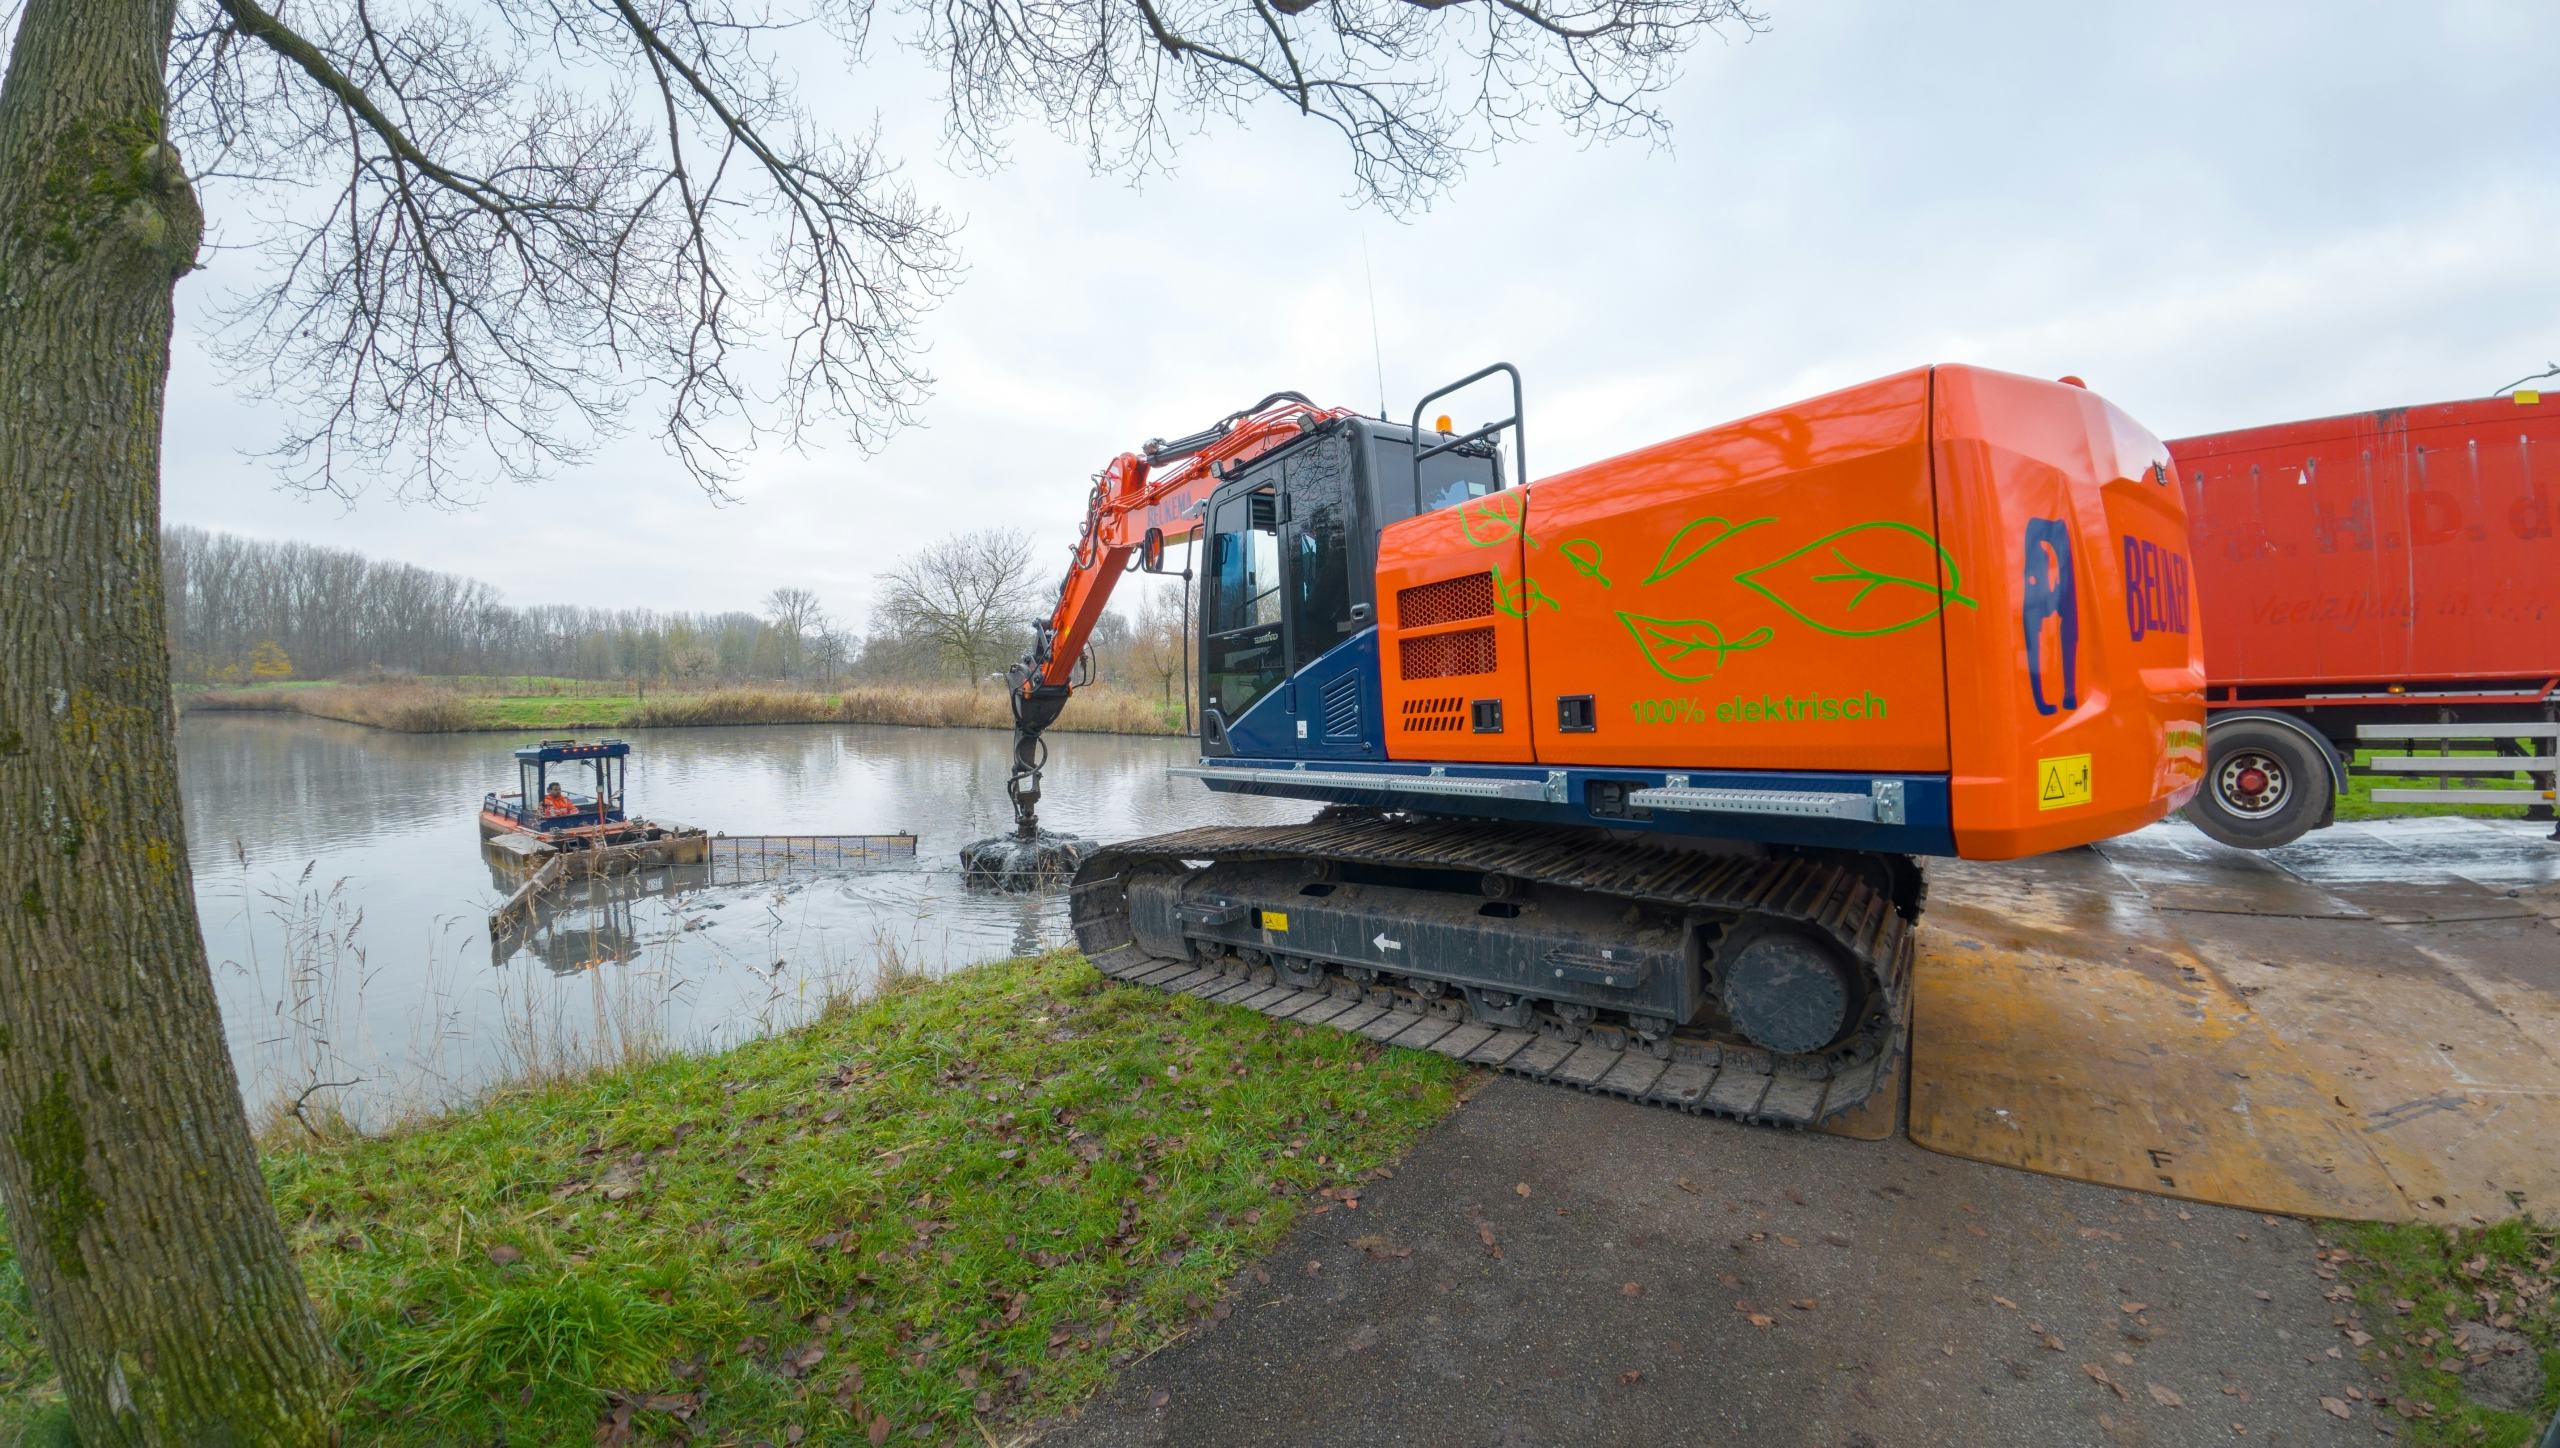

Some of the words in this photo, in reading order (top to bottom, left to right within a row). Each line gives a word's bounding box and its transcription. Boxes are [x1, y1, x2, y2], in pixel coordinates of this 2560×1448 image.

[2123, 534, 2189, 642] BEUKE
[1631, 697, 1705, 724] 100%
[1715, 689, 1888, 722] elektrisch
